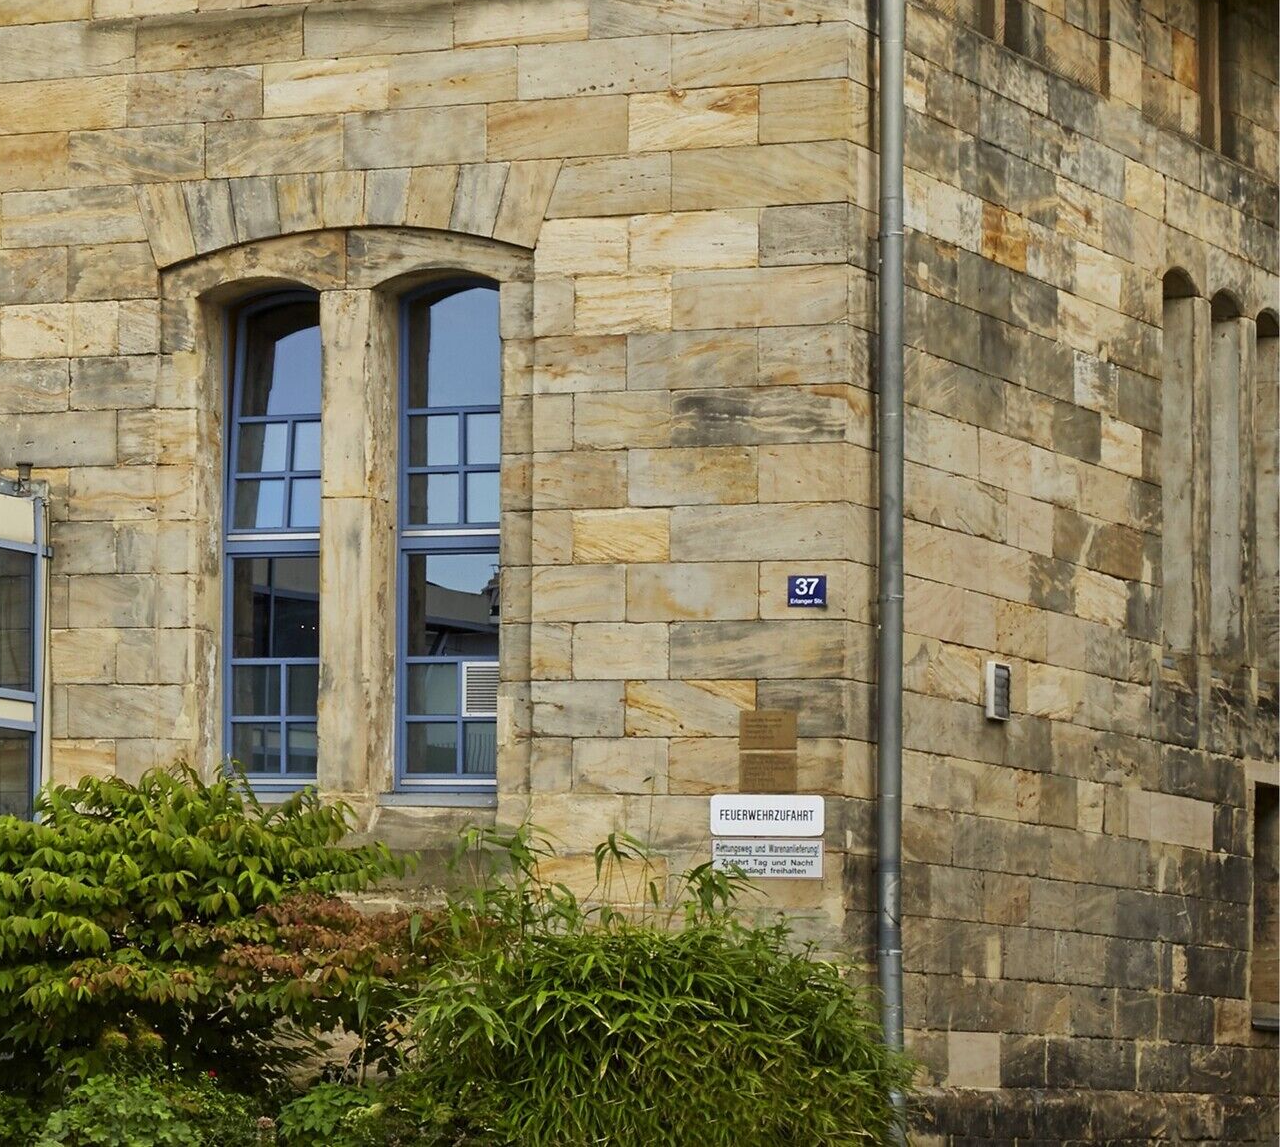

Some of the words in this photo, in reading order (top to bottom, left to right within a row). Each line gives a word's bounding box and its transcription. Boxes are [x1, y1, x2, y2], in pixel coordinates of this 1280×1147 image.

[795, 577, 819, 595] 37
[719, 809, 814, 821] FEUERWEHRZUFAHRT
[715, 843, 753, 855] Rettungsweg
[755, 845, 767, 853] und
[753, 859, 768, 867] Tag
[790, 859, 814, 867] Nacht
